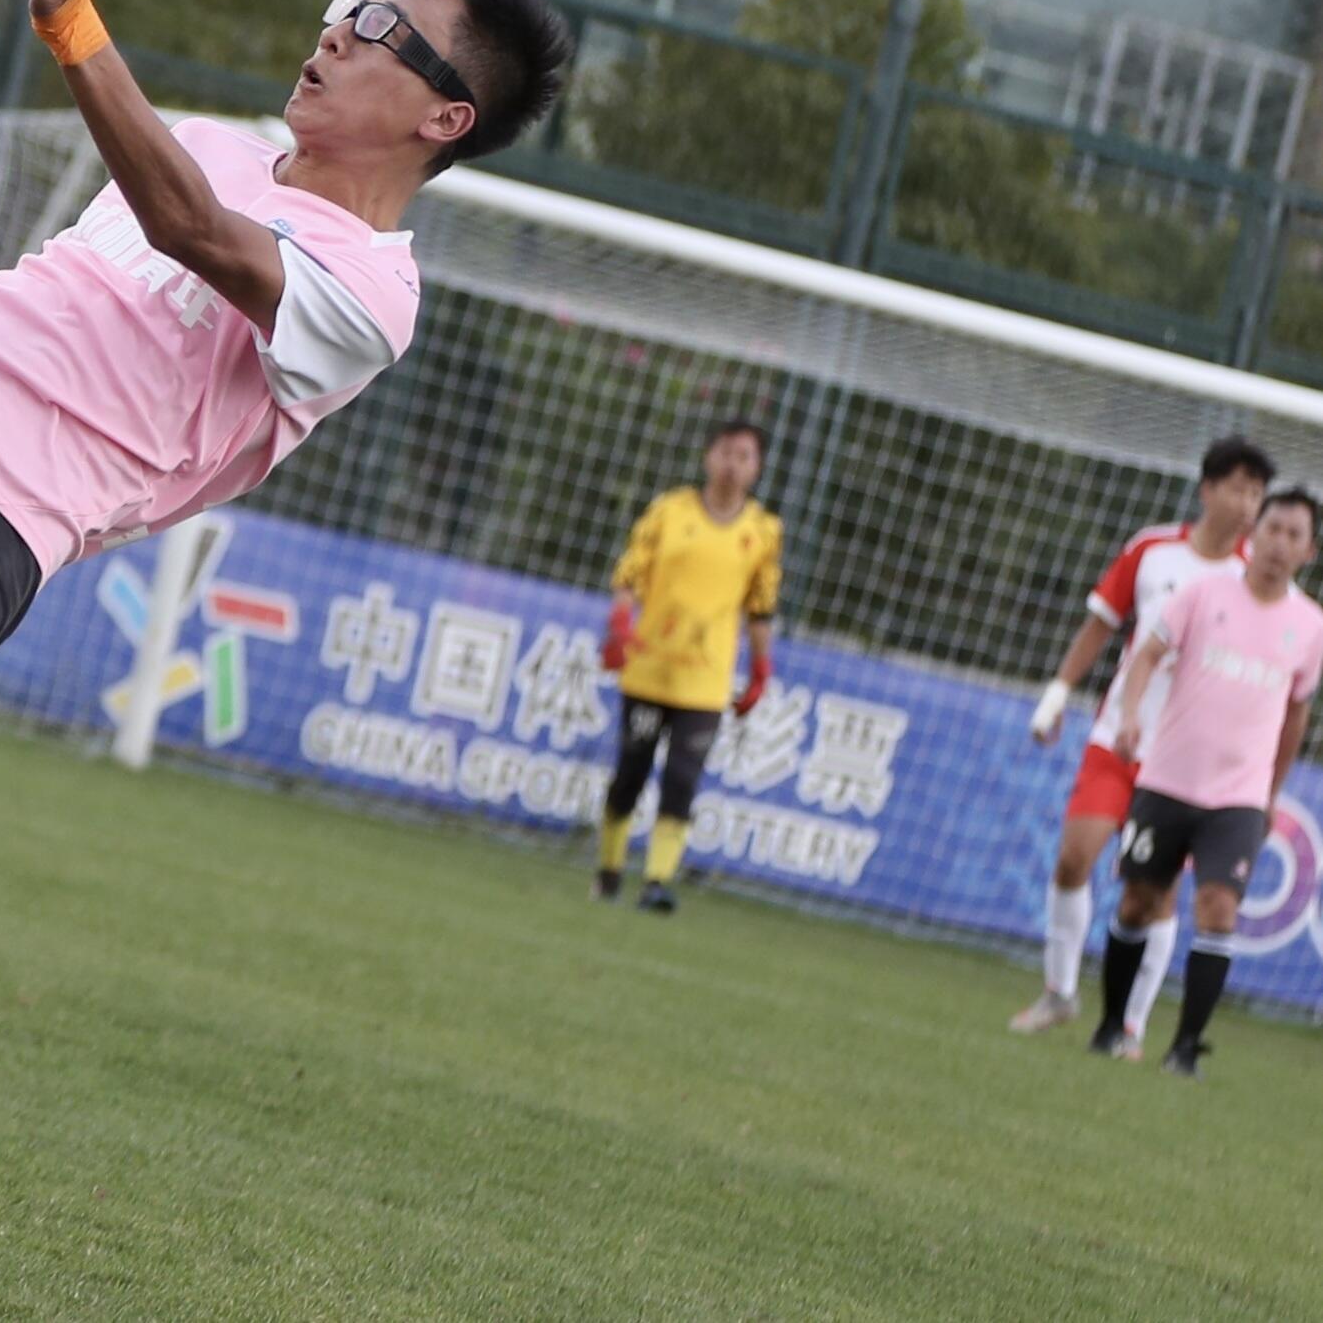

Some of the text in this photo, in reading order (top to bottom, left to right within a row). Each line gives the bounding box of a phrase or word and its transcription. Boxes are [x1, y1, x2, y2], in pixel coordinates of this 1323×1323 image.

[300, 701, 458, 791] CHINA
[686, 790, 881, 886] OTTERY
[320, 581, 909, 819] 中国体彩票
